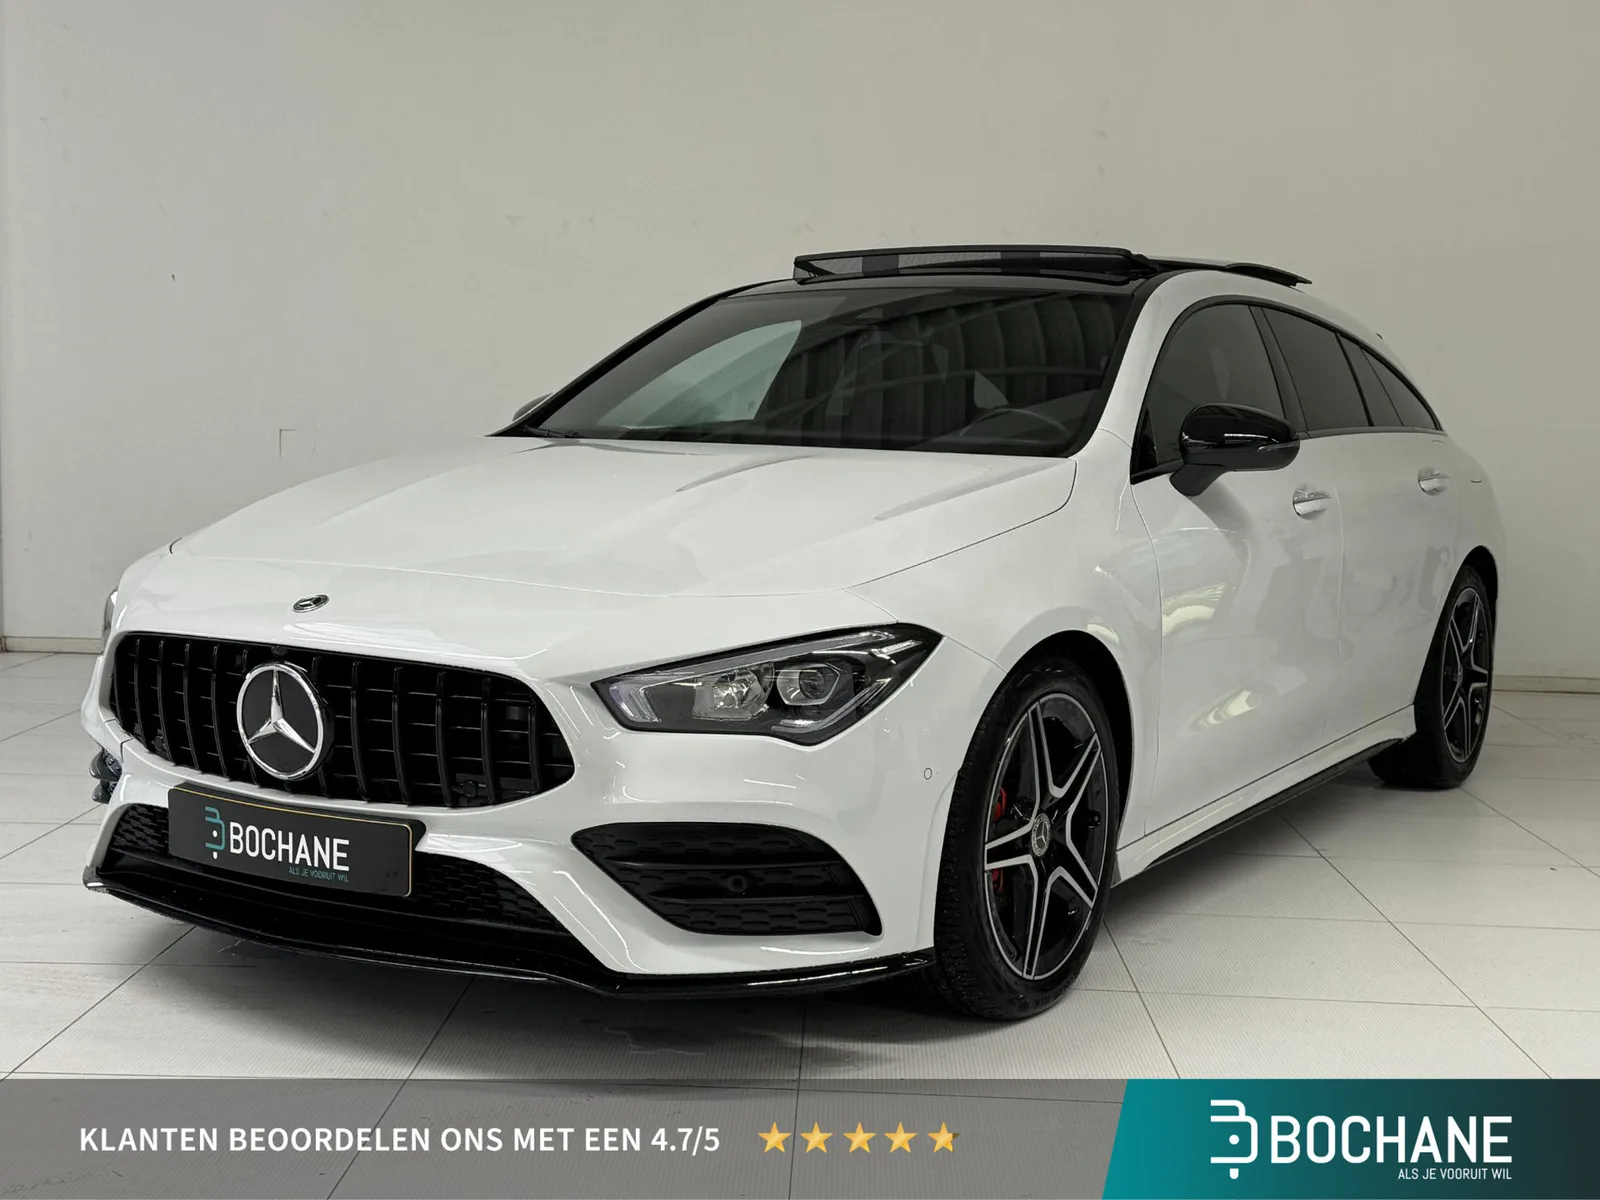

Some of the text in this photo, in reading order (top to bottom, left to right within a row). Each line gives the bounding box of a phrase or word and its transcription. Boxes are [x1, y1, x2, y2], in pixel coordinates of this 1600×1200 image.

[230, 821, 349, 871] BOCHANE
[288, 866, 300, 876] ALS
[337, 872, 350, 883] WIL
